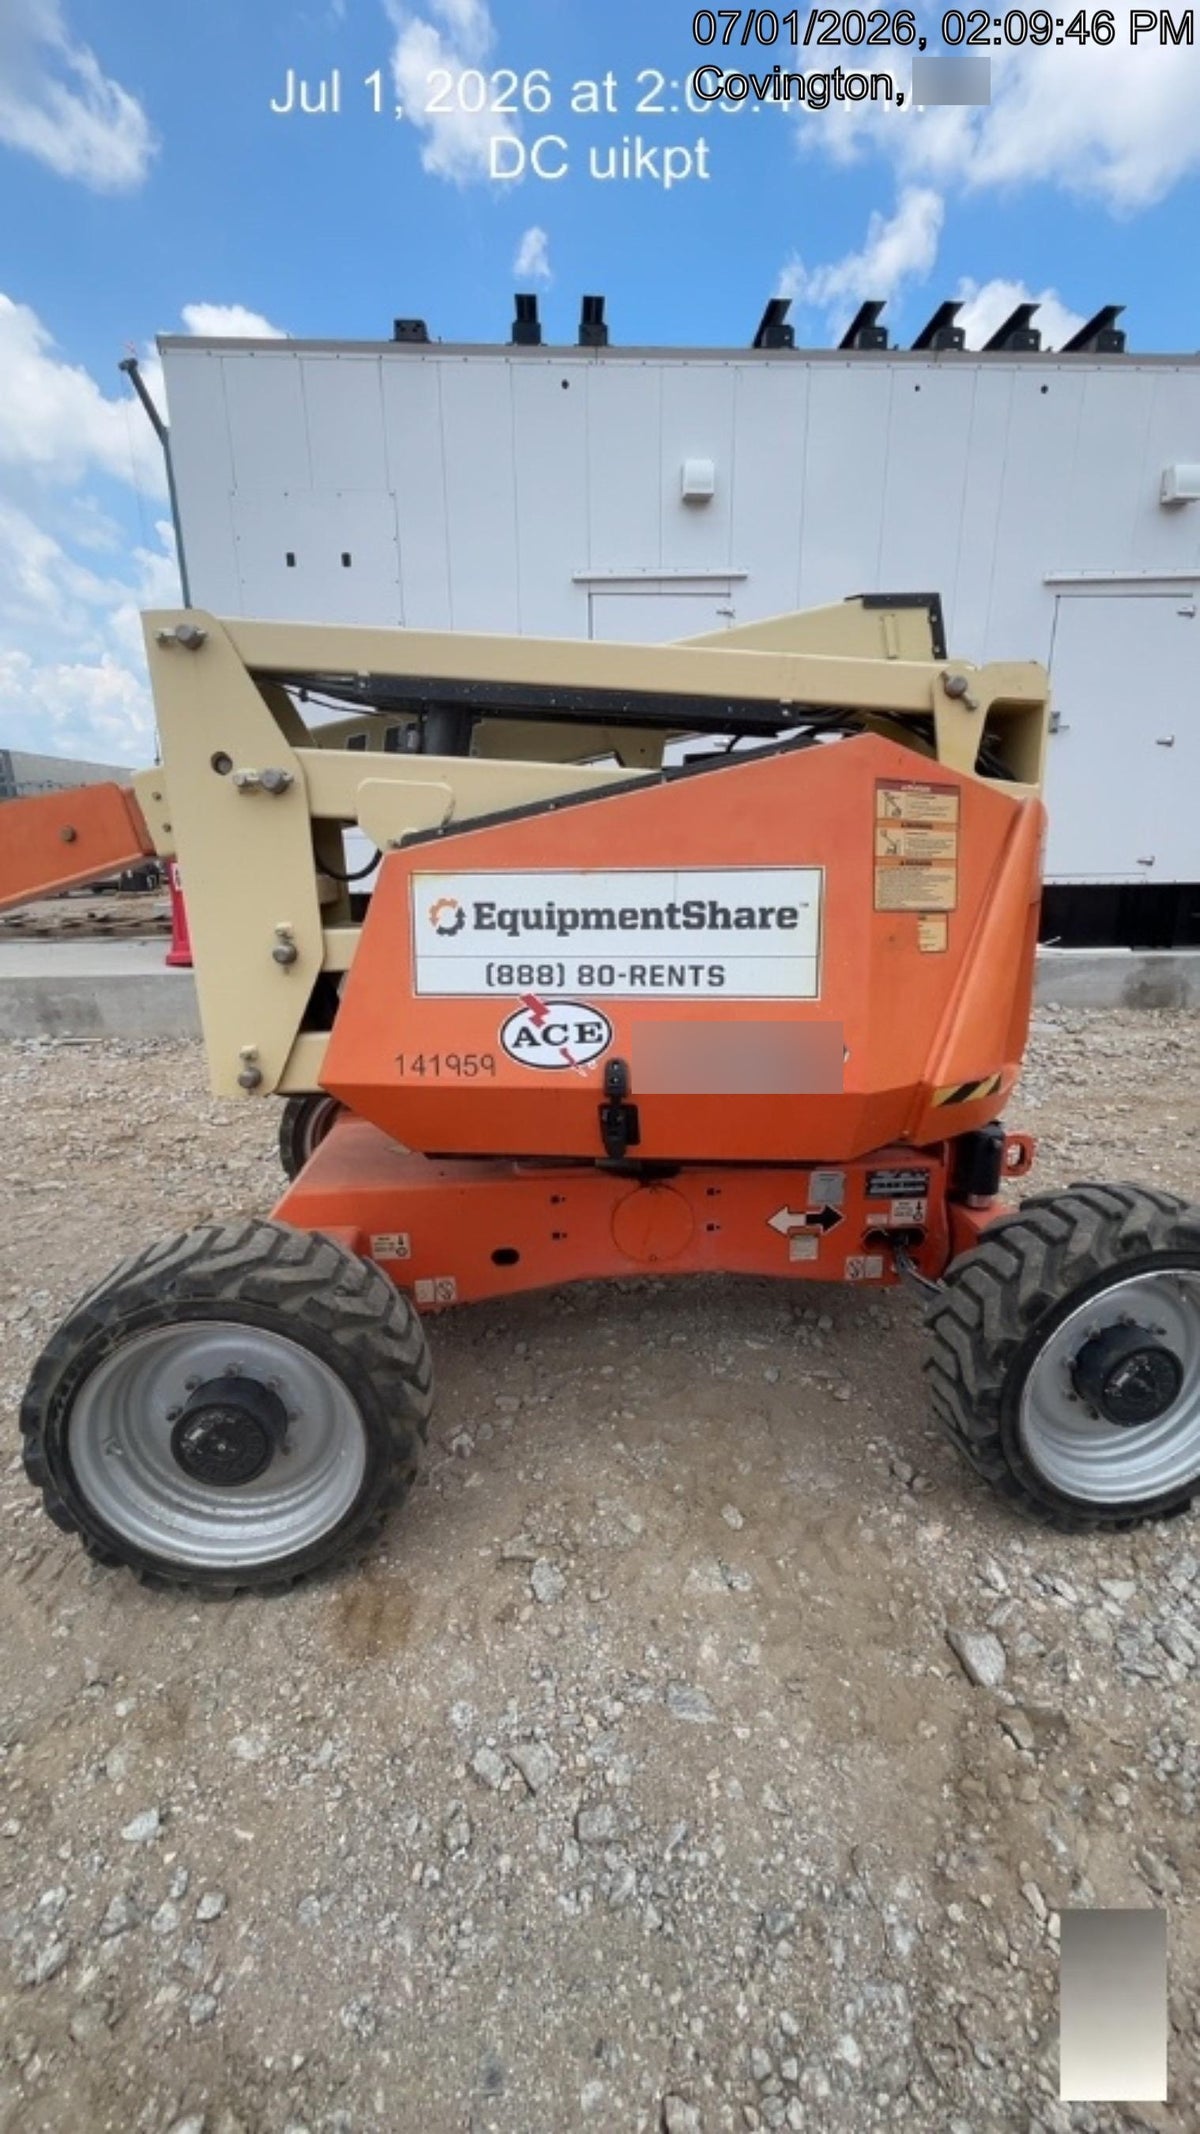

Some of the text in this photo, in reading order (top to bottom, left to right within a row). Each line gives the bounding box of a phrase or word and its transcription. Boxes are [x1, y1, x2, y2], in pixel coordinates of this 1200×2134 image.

[485, 962, 726, 988] (888) 80-RENTS
[511, 1021, 604, 1049] ACE
[394, 1053, 497, 1078] 141959
